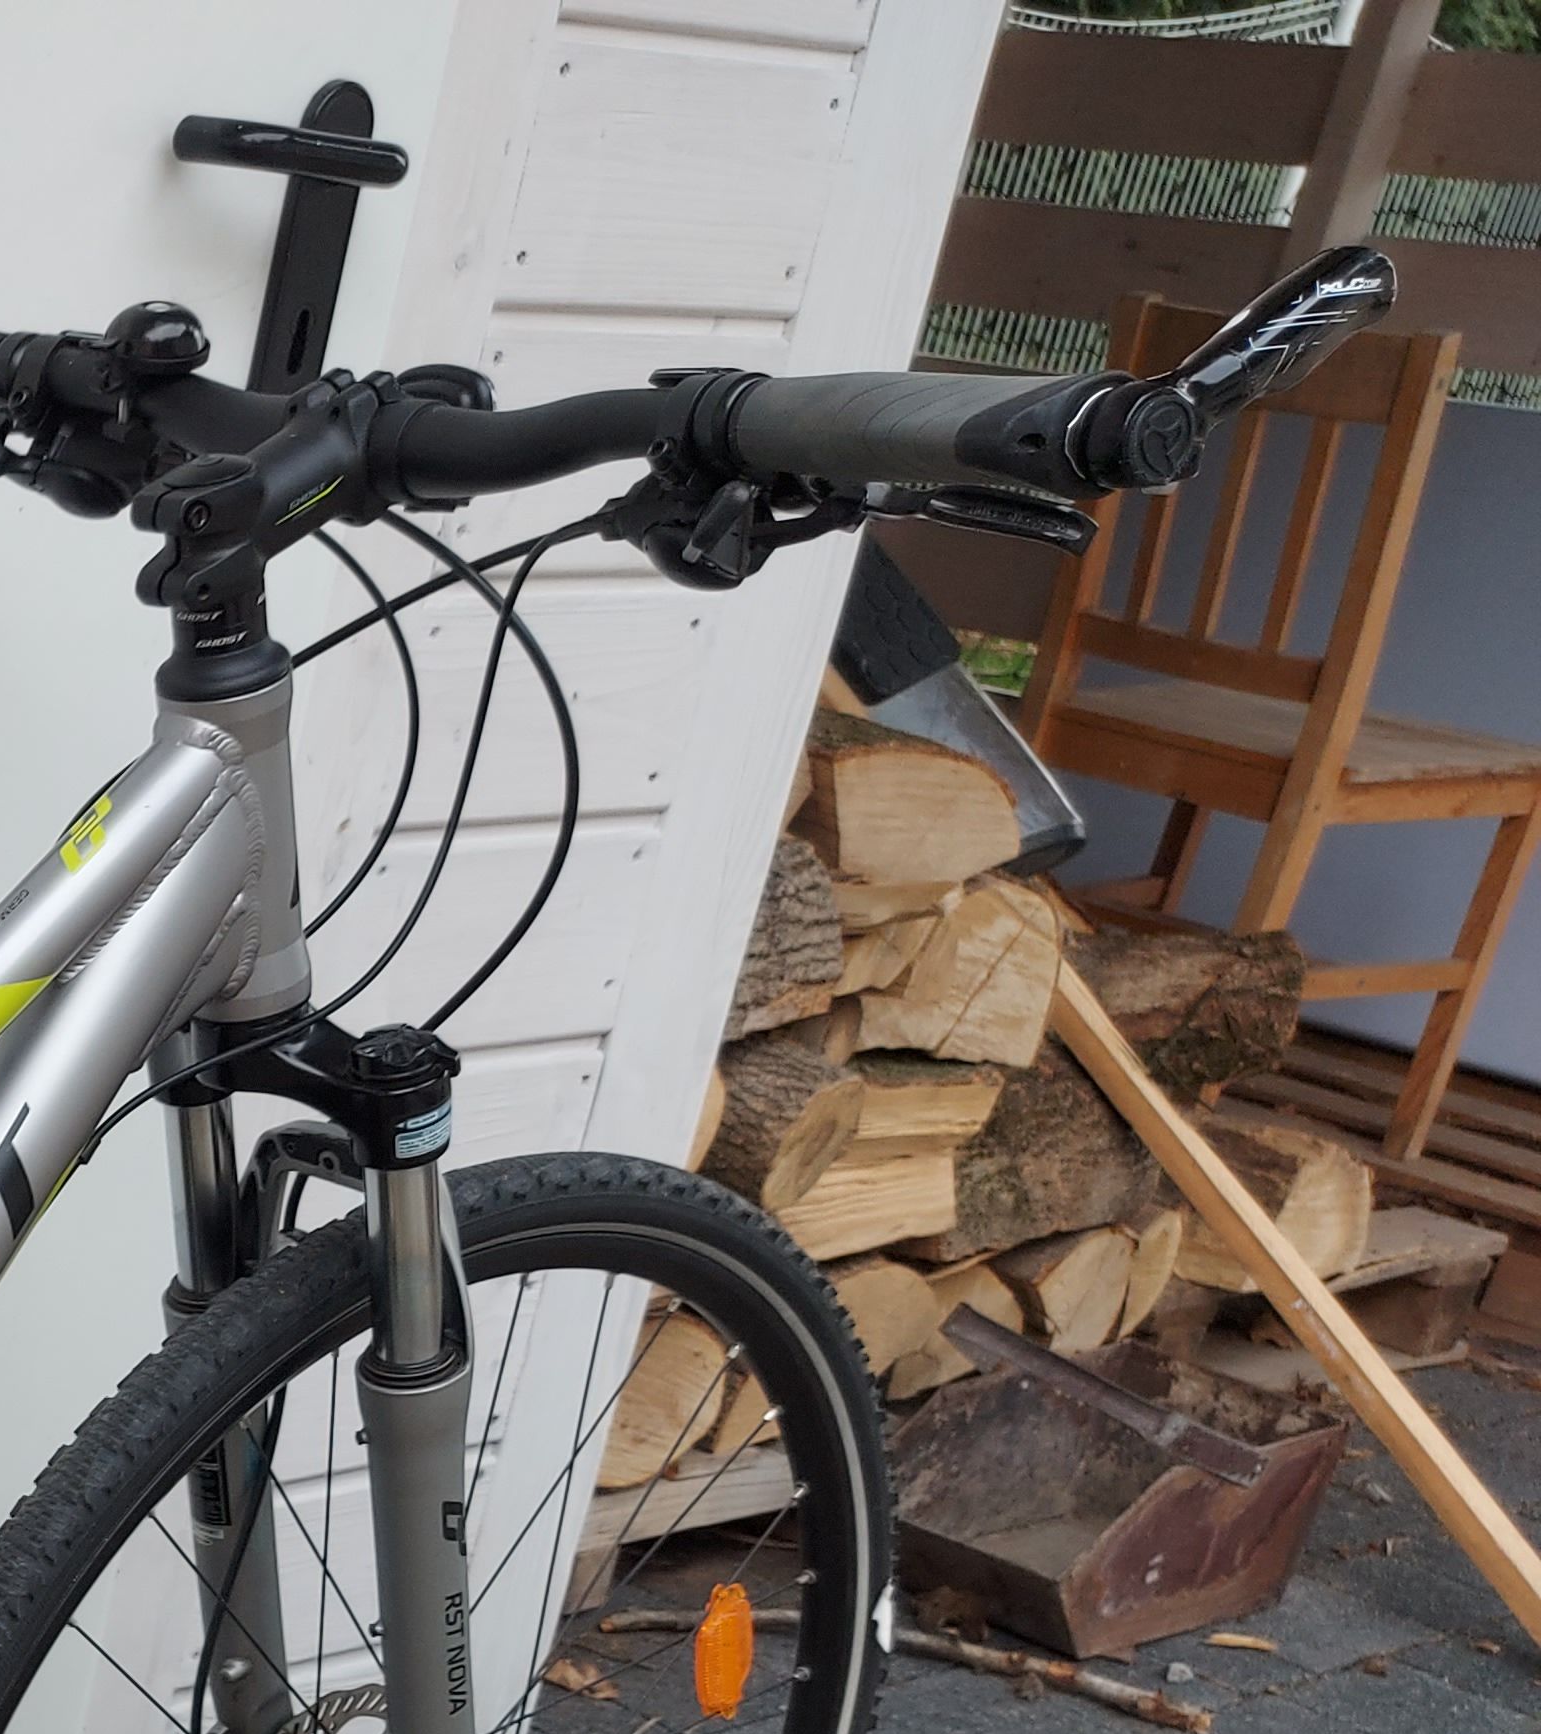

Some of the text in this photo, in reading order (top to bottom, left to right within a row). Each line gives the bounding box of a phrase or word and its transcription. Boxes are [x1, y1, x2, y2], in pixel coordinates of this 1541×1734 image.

[195, 630, 249, 649] GHOST
[444, 1591, 468, 1716] RST NOVA
